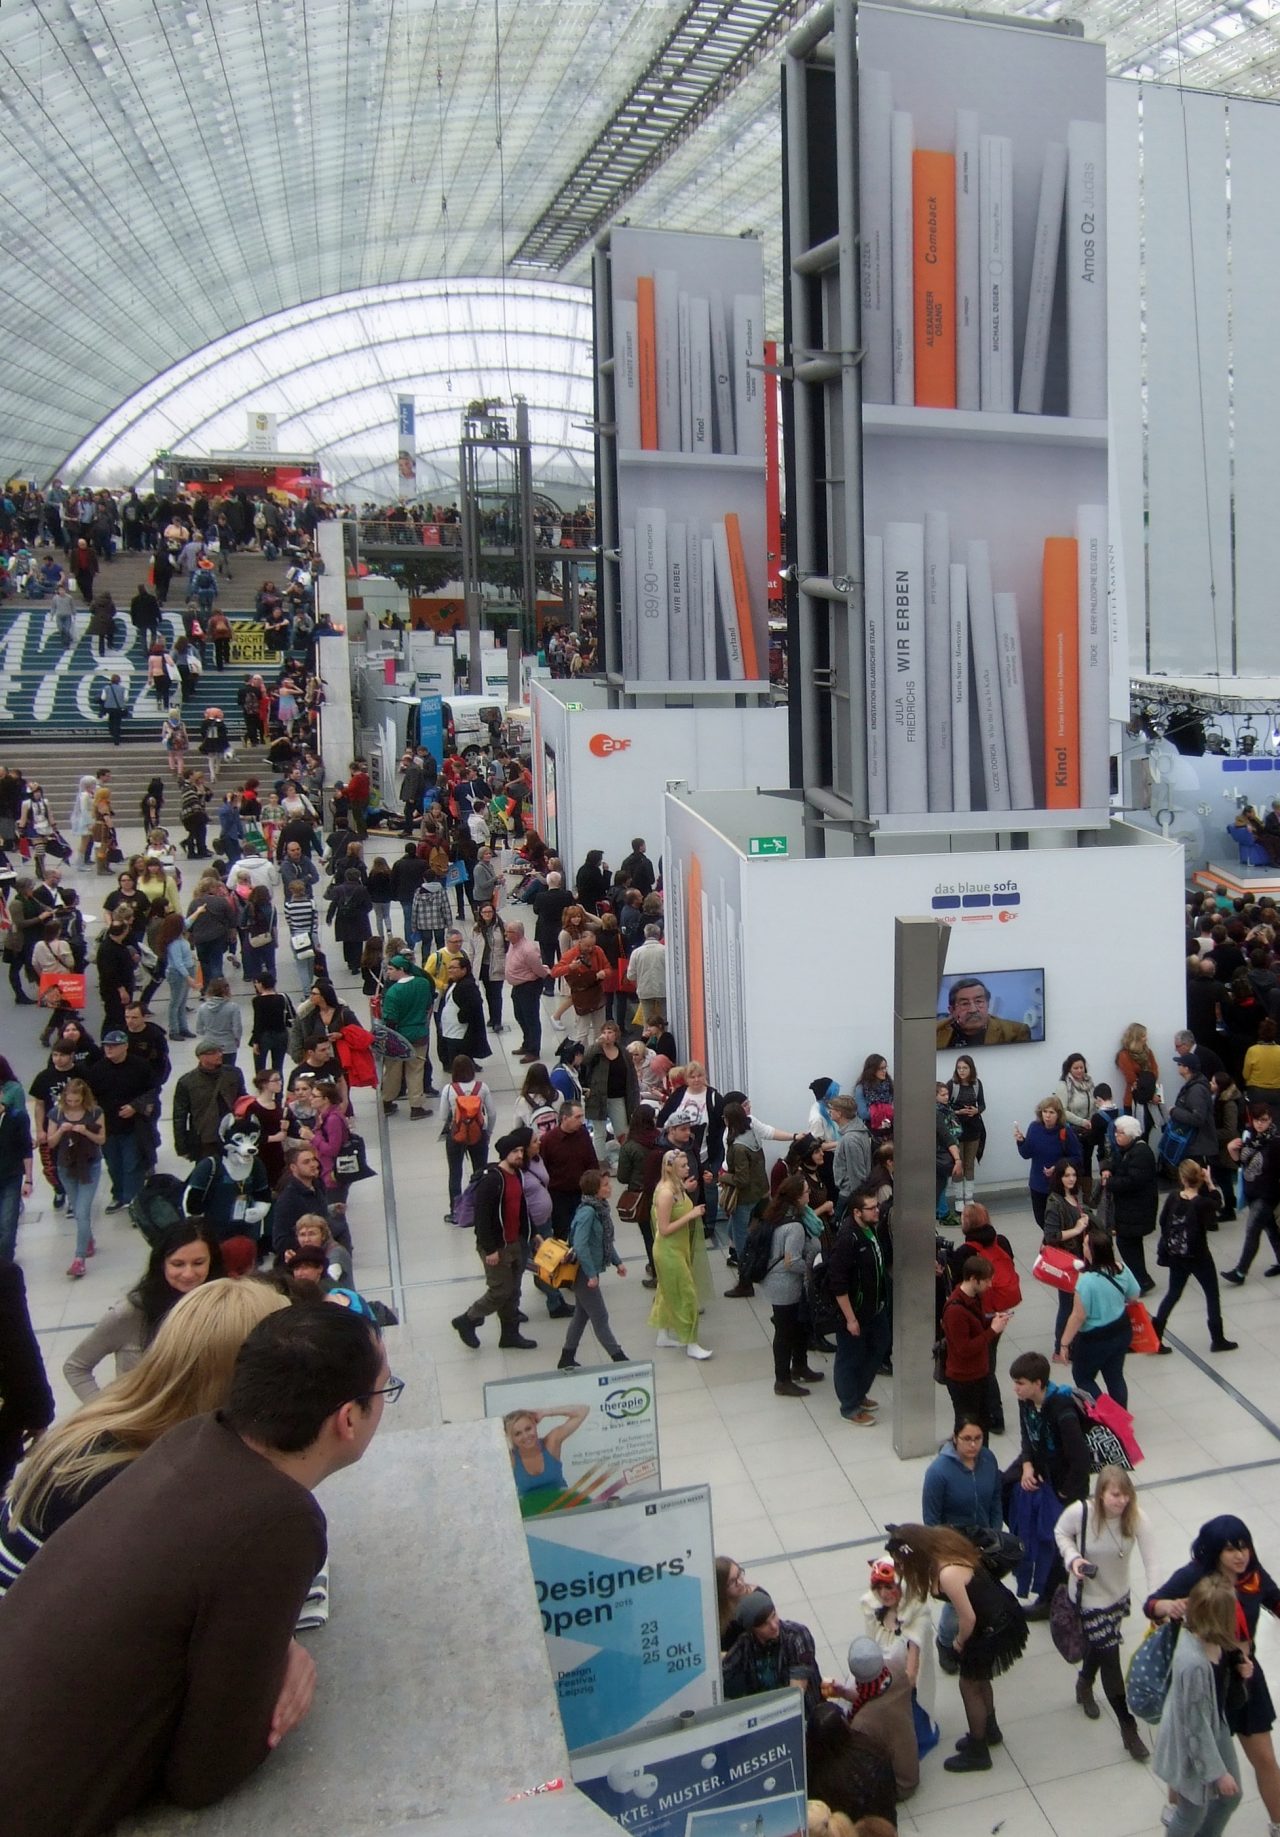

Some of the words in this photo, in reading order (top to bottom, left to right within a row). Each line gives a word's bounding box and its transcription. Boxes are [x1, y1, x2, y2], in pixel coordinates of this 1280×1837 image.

[1081, 163, 1094, 209] Judas
[925, 196, 938, 264] Comeback
[1082, 213, 1094, 234] Oz
[1082, 239, 1094, 283] Amos
[992, 284, 1000, 312] DEGEN
[926, 291, 934, 347] ALEXANDER
[935, 304, 943, 336] OSANG
[992, 315, 1000, 352] MICHAEL
[696, 418, 704, 442] Kino!
[1089, 538, 1098, 562] GELDES
[1089, 563, 1098, 575] DES
[644, 573, 660, 619] 89/90
[896, 570, 910, 631] ERBEN
[1089, 576, 1098, 615] PHILOSOPHIE
[727, 628, 740, 663] Aberland
[897, 638, 910, 673] WIR
[955, 680, 963, 704] Martin
[895, 697, 904, 726] JULIA
[906, 680, 916, 742] FRIEDRICHS
[1057, 714, 1065, 737] Florian
[989, 743, 999, 770] DORON
[1055, 747, 1068, 787] Kino!
[991, 771, 1001, 792] LIZZIE
[934, 881, 956, 895] das
[957, 880, 991, 894] blaue
[993, 879, 1018, 893] sofa
[600, 1397, 643, 1412] therapie
[614, 1598, 634, 1609] 2015
[641, 1620, 659, 1636] 23
[642, 1635, 660, 1650] 24
[643, 1650, 661, 1665] 25
[666, 1641, 693, 1659] Okt
[557, 1667, 592, 1680] Design
[667, 1654, 703, 1674] 2015
[558, 1674, 597, 1688] Festival
[558, 1684, 595, 1698] Leipzig
[658, 1776, 725, 1812] MUSTER.
[729, 1743, 792, 1782] MESSEN.
